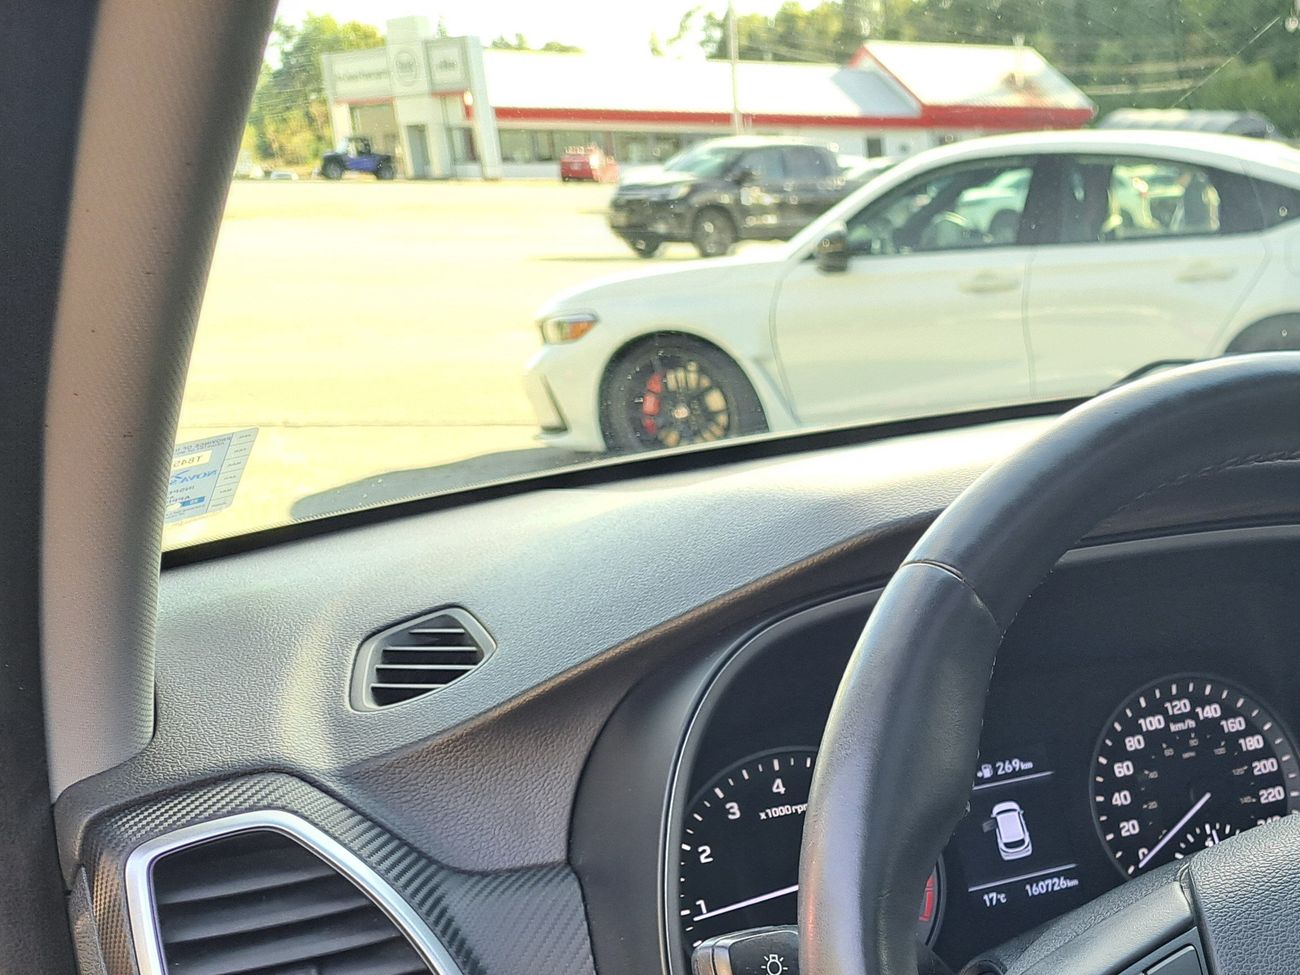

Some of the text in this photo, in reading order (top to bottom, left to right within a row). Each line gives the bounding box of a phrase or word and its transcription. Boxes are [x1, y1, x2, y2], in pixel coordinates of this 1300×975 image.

[1164, 699, 1191, 715] 120
[1195, 704, 1221, 720] 140
[1138, 715, 1165, 731] 100
[1169, 719, 1196, 732] km/h
[1220, 716, 1246, 733] 160
[1125, 735, 1145, 751] 80
[1238, 735, 1264, 751] 180
[1114, 761, 1134, 778] 60
[1252, 758, 1278, 775] 200
[772, 778, 786, 794] 4
[1112, 790, 1132, 807] 40
[1259, 786, 1285, 804] 220
[725, 802, 741, 820] 3
[1120, 819, 1140, 837] 20
[697, 845, 714, 864] 2
[695, 899, 707, 914] 1
